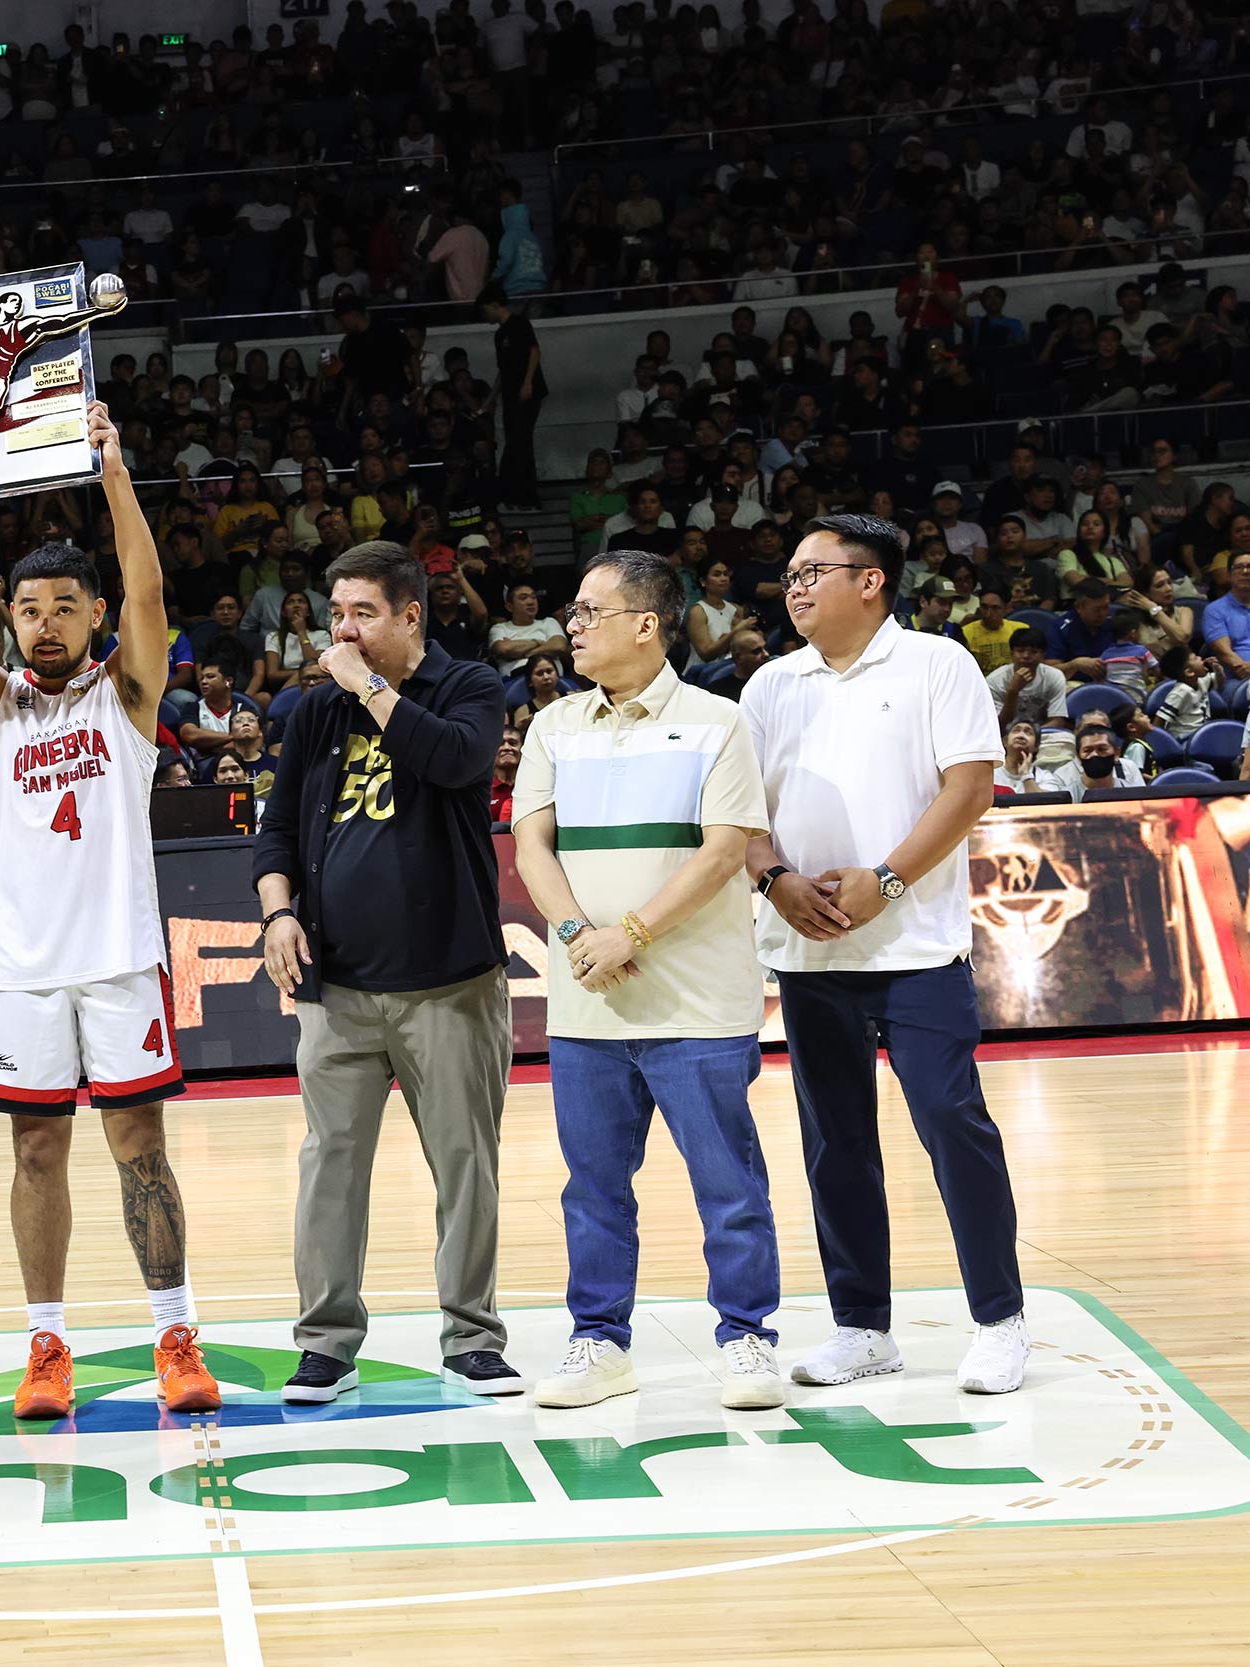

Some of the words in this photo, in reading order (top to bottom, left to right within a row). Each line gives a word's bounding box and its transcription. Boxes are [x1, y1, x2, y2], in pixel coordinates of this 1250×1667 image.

[161, 34, 186, 46] EXIT
[35, 283, 70, 293] POCARI
[36, 290, 66, 298] SWEAT
[32, 364, 49, 373] BEST
[51, 360, 75, 369] PLAYER
[54, 368, 67, 376] THE
[35, 375, 75, 387] CONFERENCE
[30, 718, 89, 743] BARANGAY
[13, 728, 112, 782] GINEBRA
[22, 775, 52, 795] SAN
[56, 759, 106, 790] MGUEL
[333, 770, 396, 823] 50
[50, 790, 82, 841] 4
[141, 1018, 164, 1058] 4
